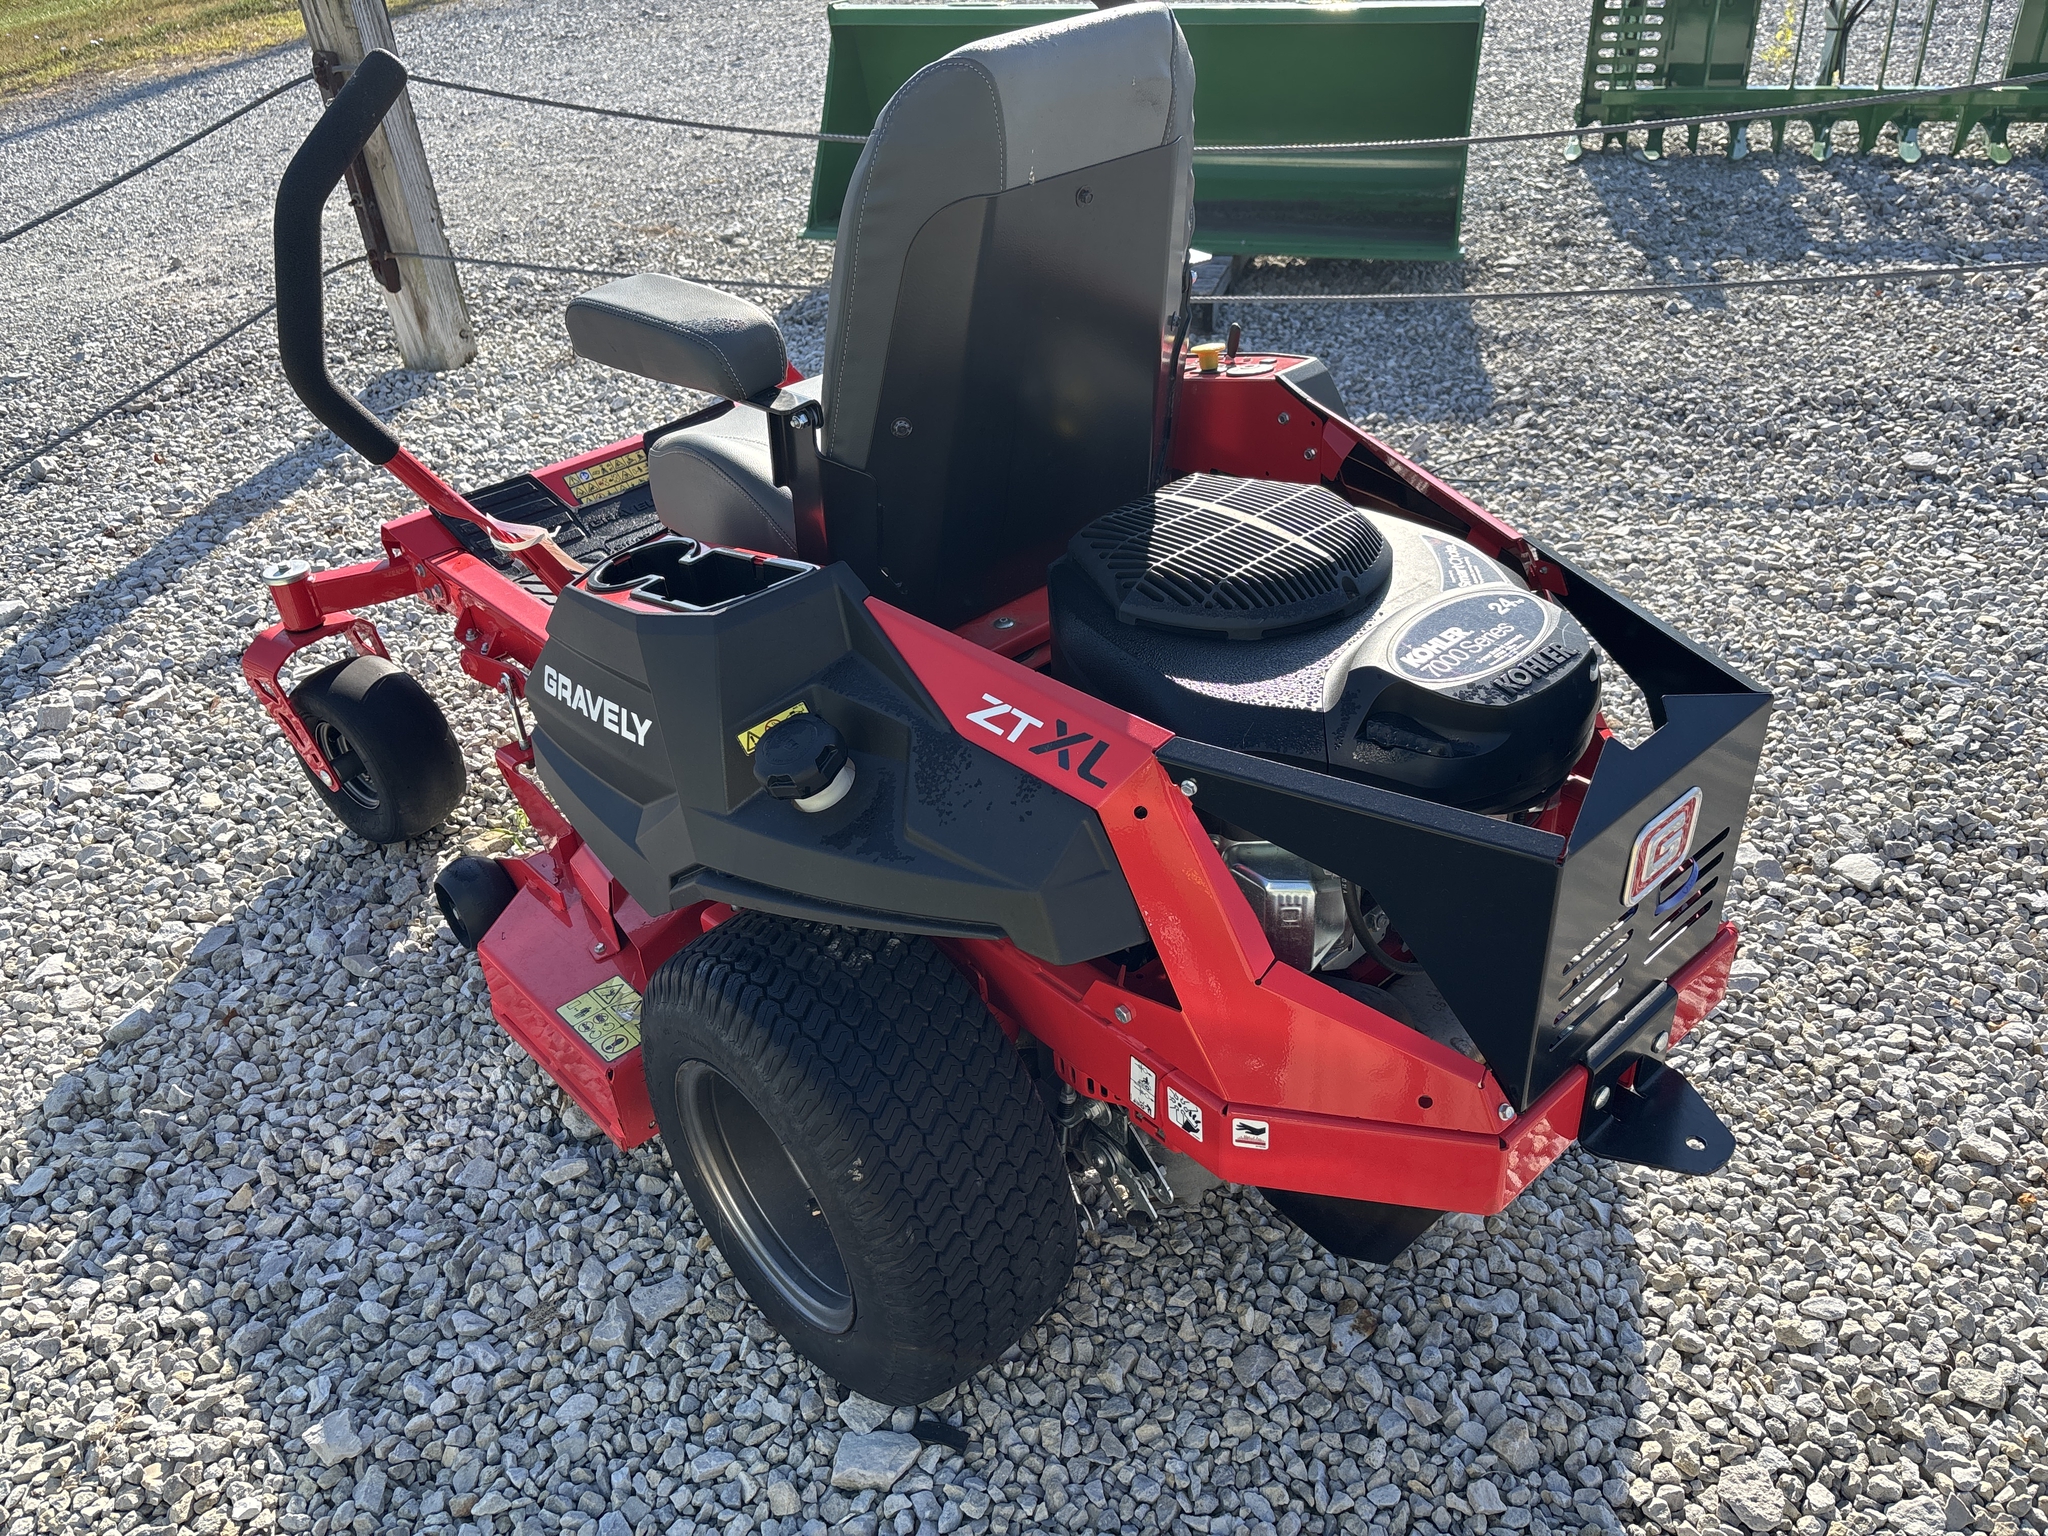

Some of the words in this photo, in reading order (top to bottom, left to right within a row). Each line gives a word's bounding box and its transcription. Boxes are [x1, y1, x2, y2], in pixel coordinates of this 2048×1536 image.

[1488, 597, 1510, 615] 24
[1400, 626, 1474, 668] KOHLER
[1420, 648, 1470, 677] 7000
[1459, 622, 1515, 654] Series
[1492, 641, 1579, 699] KOHLER
[543, 664, 653, 747] GRAVELY
[965, 692, 1045, 744] ZT
[1028, 718, 1111, 790] XL
